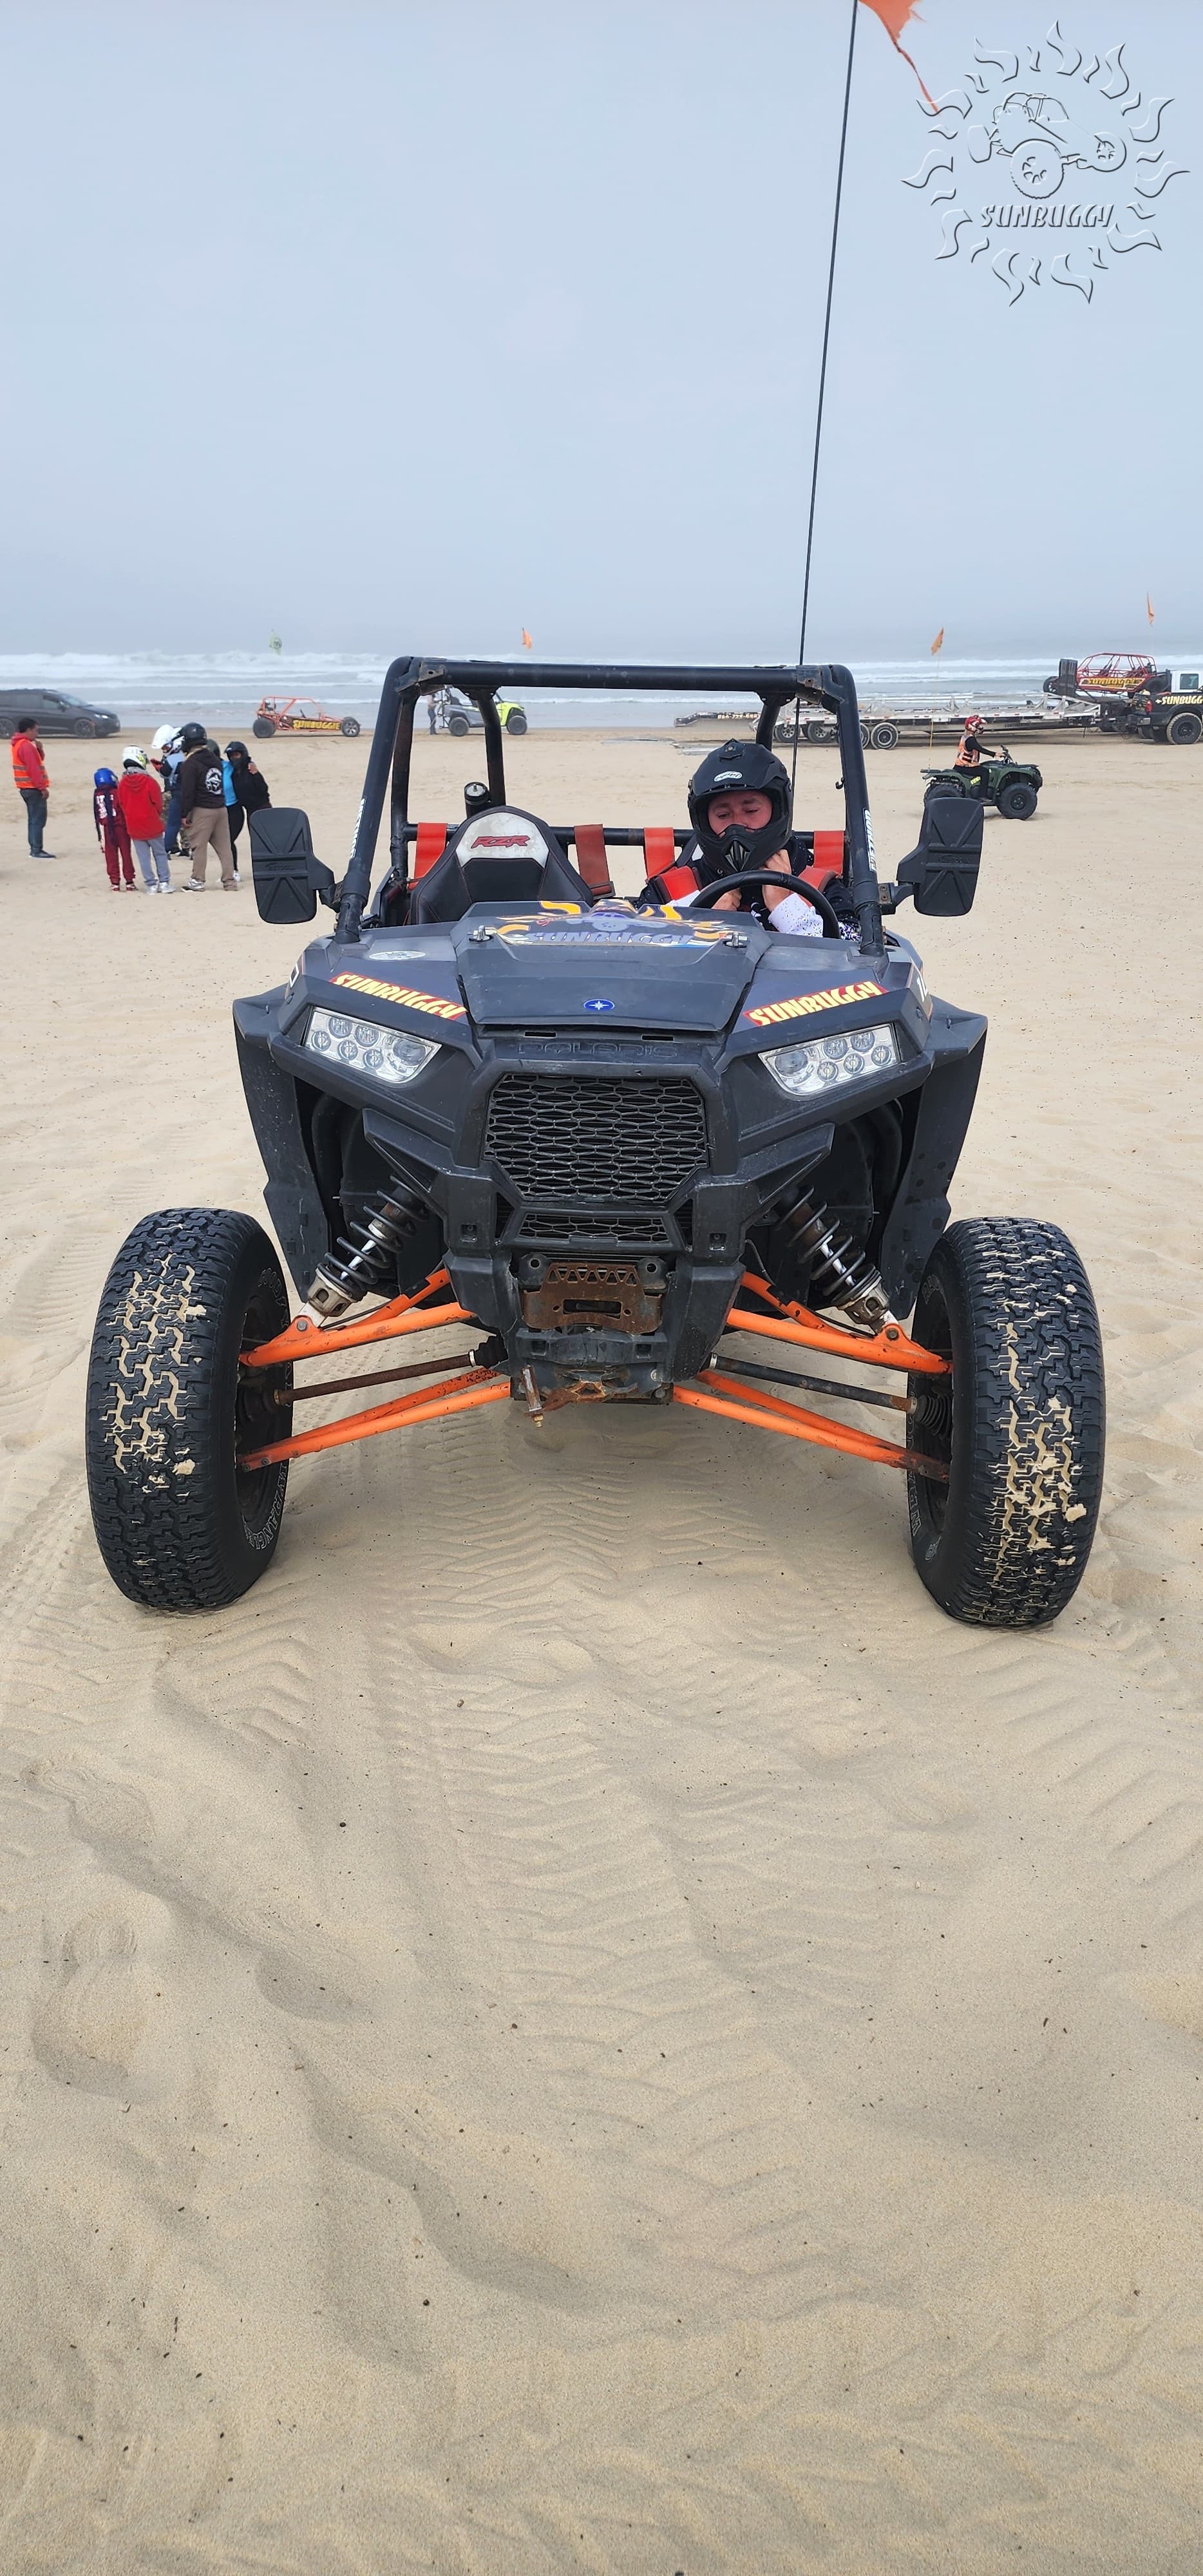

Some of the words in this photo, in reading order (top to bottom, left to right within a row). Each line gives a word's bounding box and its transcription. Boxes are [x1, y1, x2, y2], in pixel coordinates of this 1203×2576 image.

[471, 835, 531, 849] RZR
[526, 932, 695, 945] SUNBUGGY
[333, 973, 469, 1019] SUNBUGGY
[748, 980, 883, 1026] SUNBUGGY
[518, 1042, 678, 1058] POLARIS
